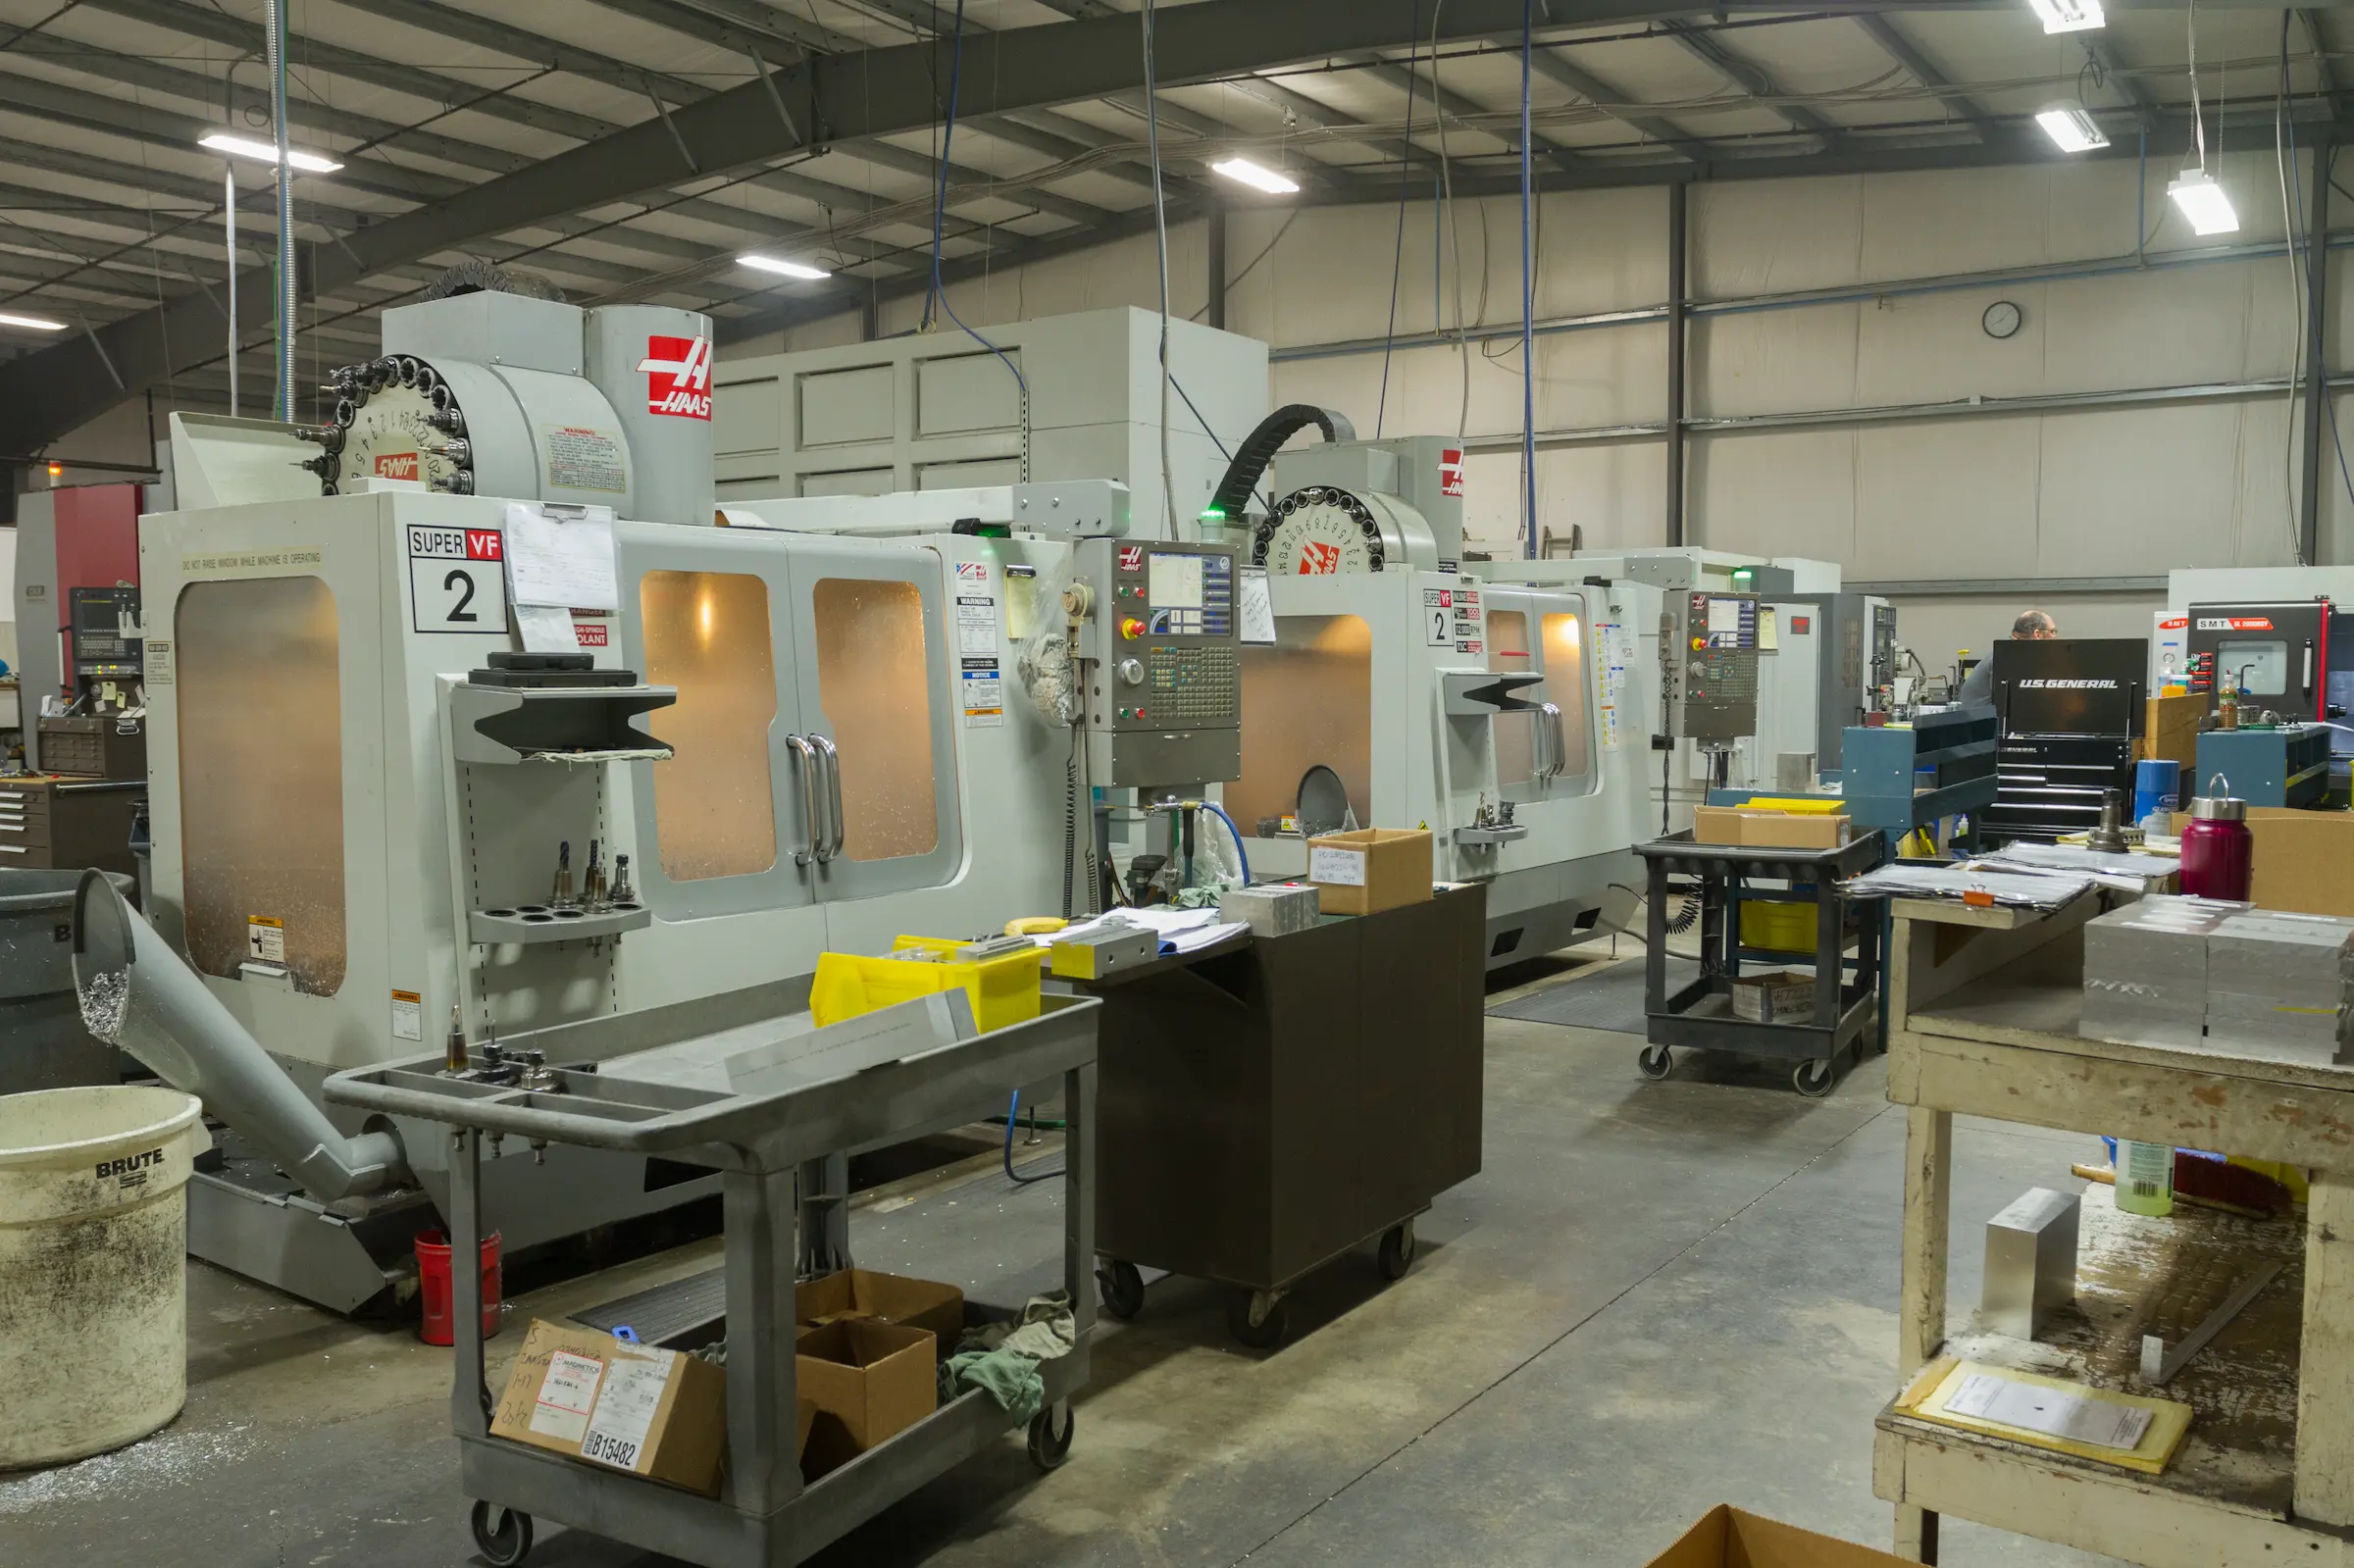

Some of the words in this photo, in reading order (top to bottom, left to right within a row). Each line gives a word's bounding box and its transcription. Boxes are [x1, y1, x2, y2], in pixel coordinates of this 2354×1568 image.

[649, 391, 712, 417] HAAS
[428, 459, 440, 477] 20
[1315, 518, 1320, 529] 8
[413, 531, 463, 554] SUPER
[470, 534, 498, 556] VF
[1282, 540, 1292, 550] 12
[182, 561, 189, 570] DO
[191, 560, 200, 569] NOT
[203, 559, 216, 569] RAISE
[218, 558, 237, 568] WINDOW
[240, 556, 255, 567] WHILE
[257, 555, 281, 566] MACHINE
[282, 554, 288, 565] IS
[290, 552, 321, 564] OPERATING
[444, 570, 478, 622] 2
[1441, 592, 1450, 605] VF
[1435, 612, 1445, 640] 2
[577, 634, 605, 644] OLANT
[96, 1148, 163, 1179] BRUTE
[563, 1360, 600, 1374] MAGNETICS
[591, 1434, 636, 1466] B15482
